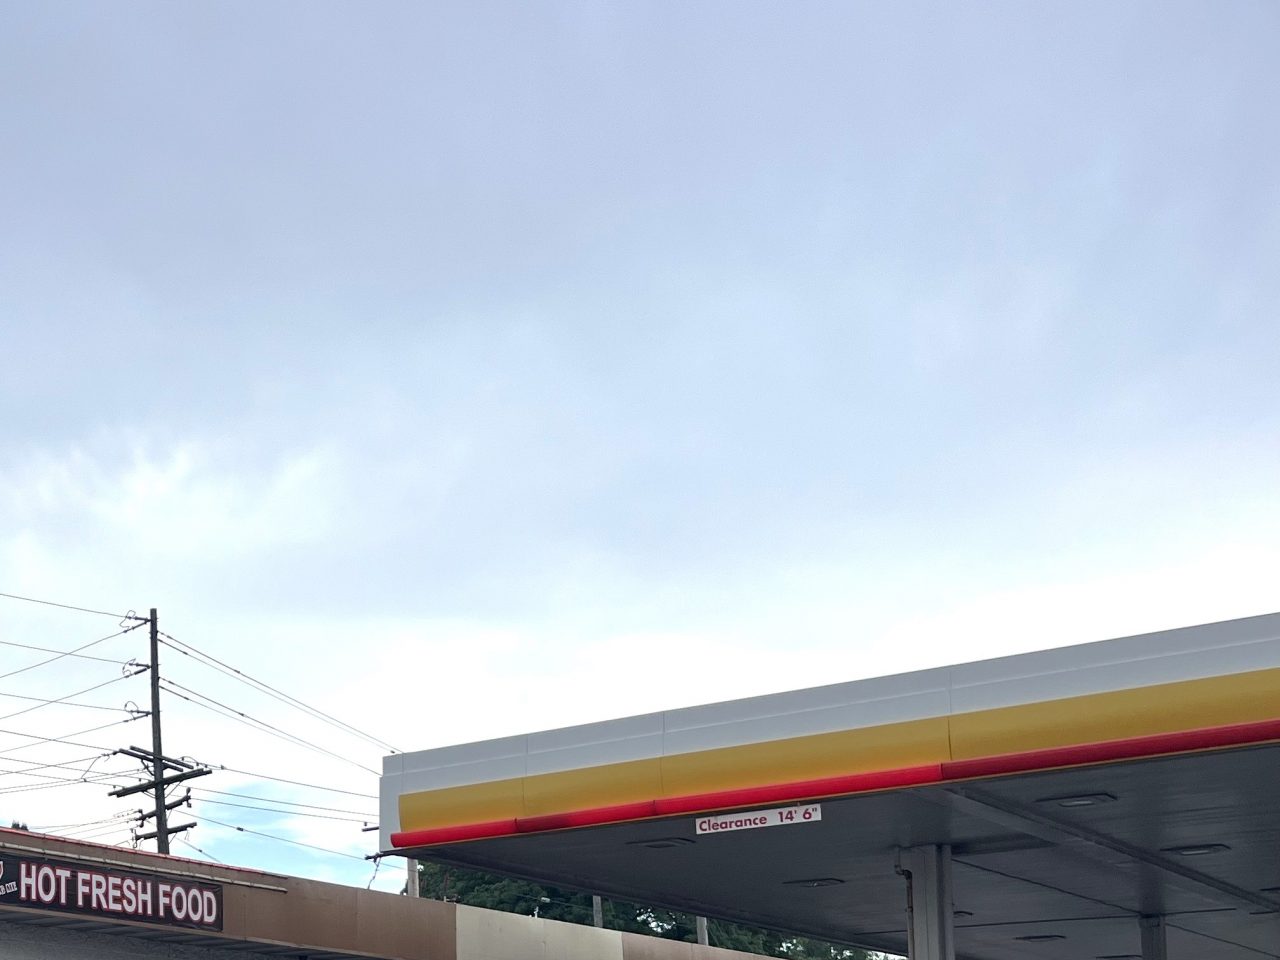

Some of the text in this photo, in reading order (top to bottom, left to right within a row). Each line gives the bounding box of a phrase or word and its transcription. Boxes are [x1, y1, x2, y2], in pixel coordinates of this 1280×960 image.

[699, 807, 818, 832] Clearance 14' 6"
[5, 881, 18, 893] ME
[20, 863, 218, 923] HOT FRESH FOOD
